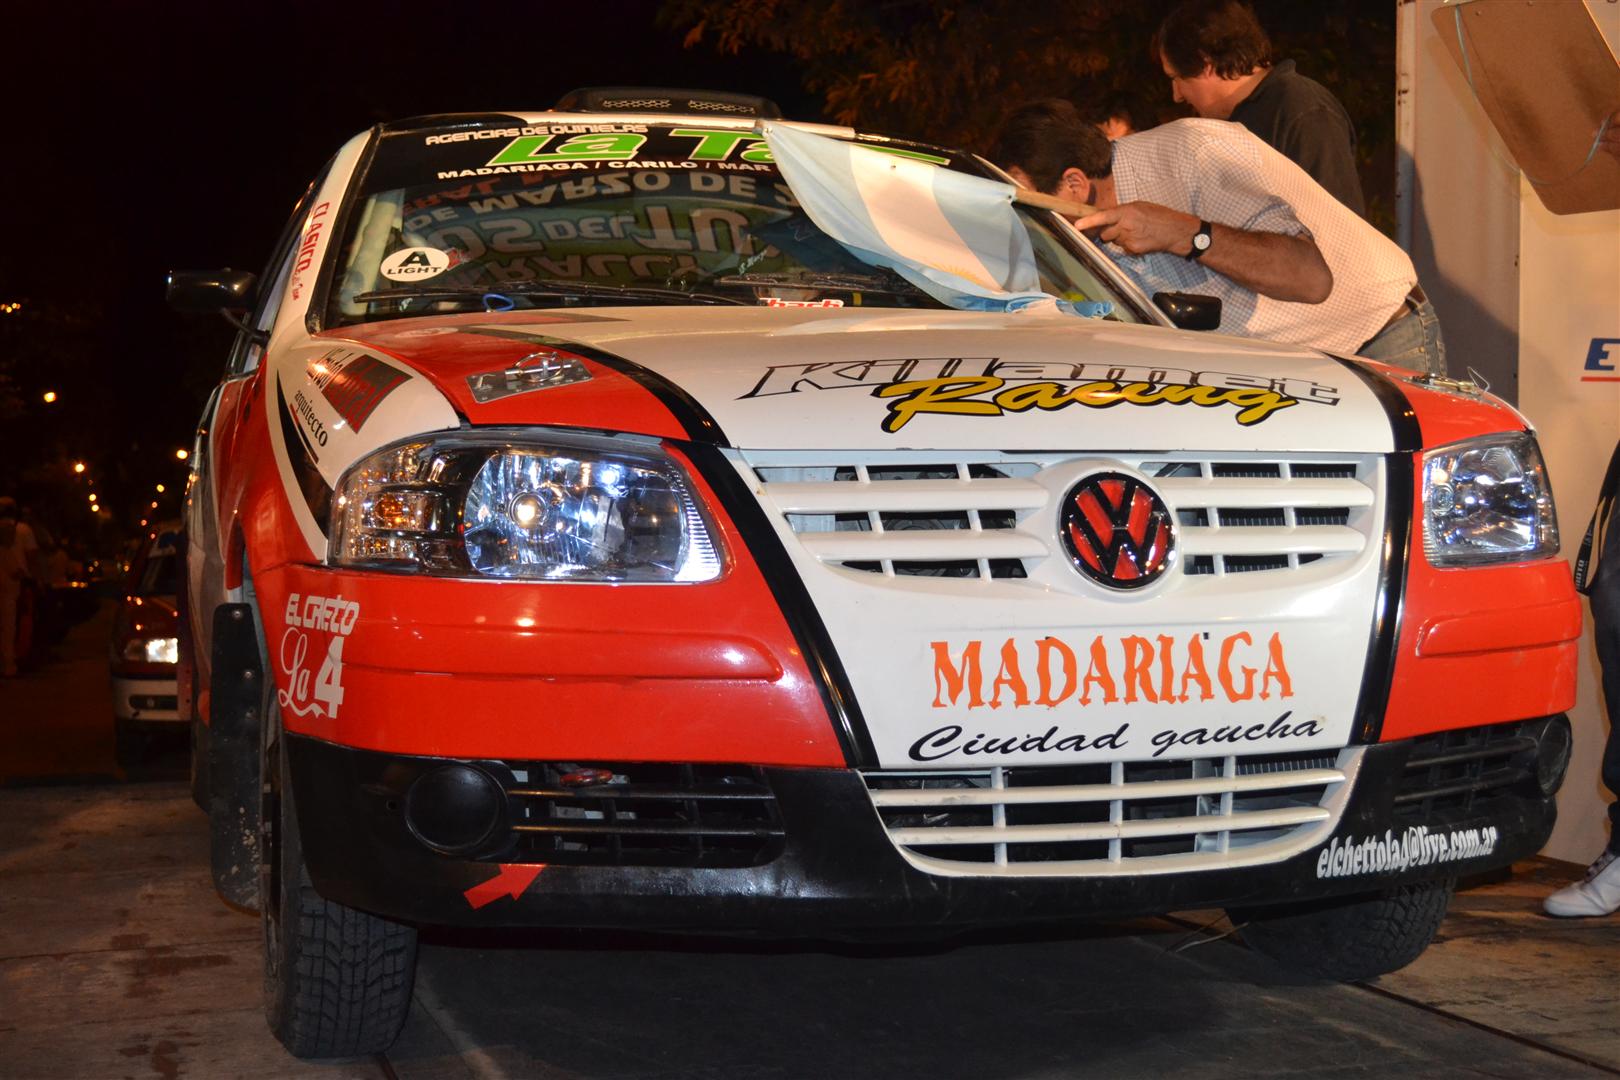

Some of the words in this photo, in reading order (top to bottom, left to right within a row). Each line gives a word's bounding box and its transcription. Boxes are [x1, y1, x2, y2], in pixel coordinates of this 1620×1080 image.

[425, 127, 521, 145] AGENCIAS
[522, 126, 548, 136] DE
[550, 124, 649, 135] QUINIELAS
[485, 133, 648, 167] La
[437, 161, 588, 180] MADARIAGA
[607, 159, 699, 170] CARILO
[718, 162, 771, 173] MAR
[296, 202, 330, 274] CLASICO
[386, 266, 442, 275] LIGHT
[398, 250, 431, 267] A
[870, 375, 1299, 433] Racing
[285, 592, 302, 626] EL
[314, 636, 345, 719] 4
[930, 631, 1294, 710] MADARIAGA
[907, 722, 1128, 762] Ciudad
[1150, 711, 1324, 759] gaucha
